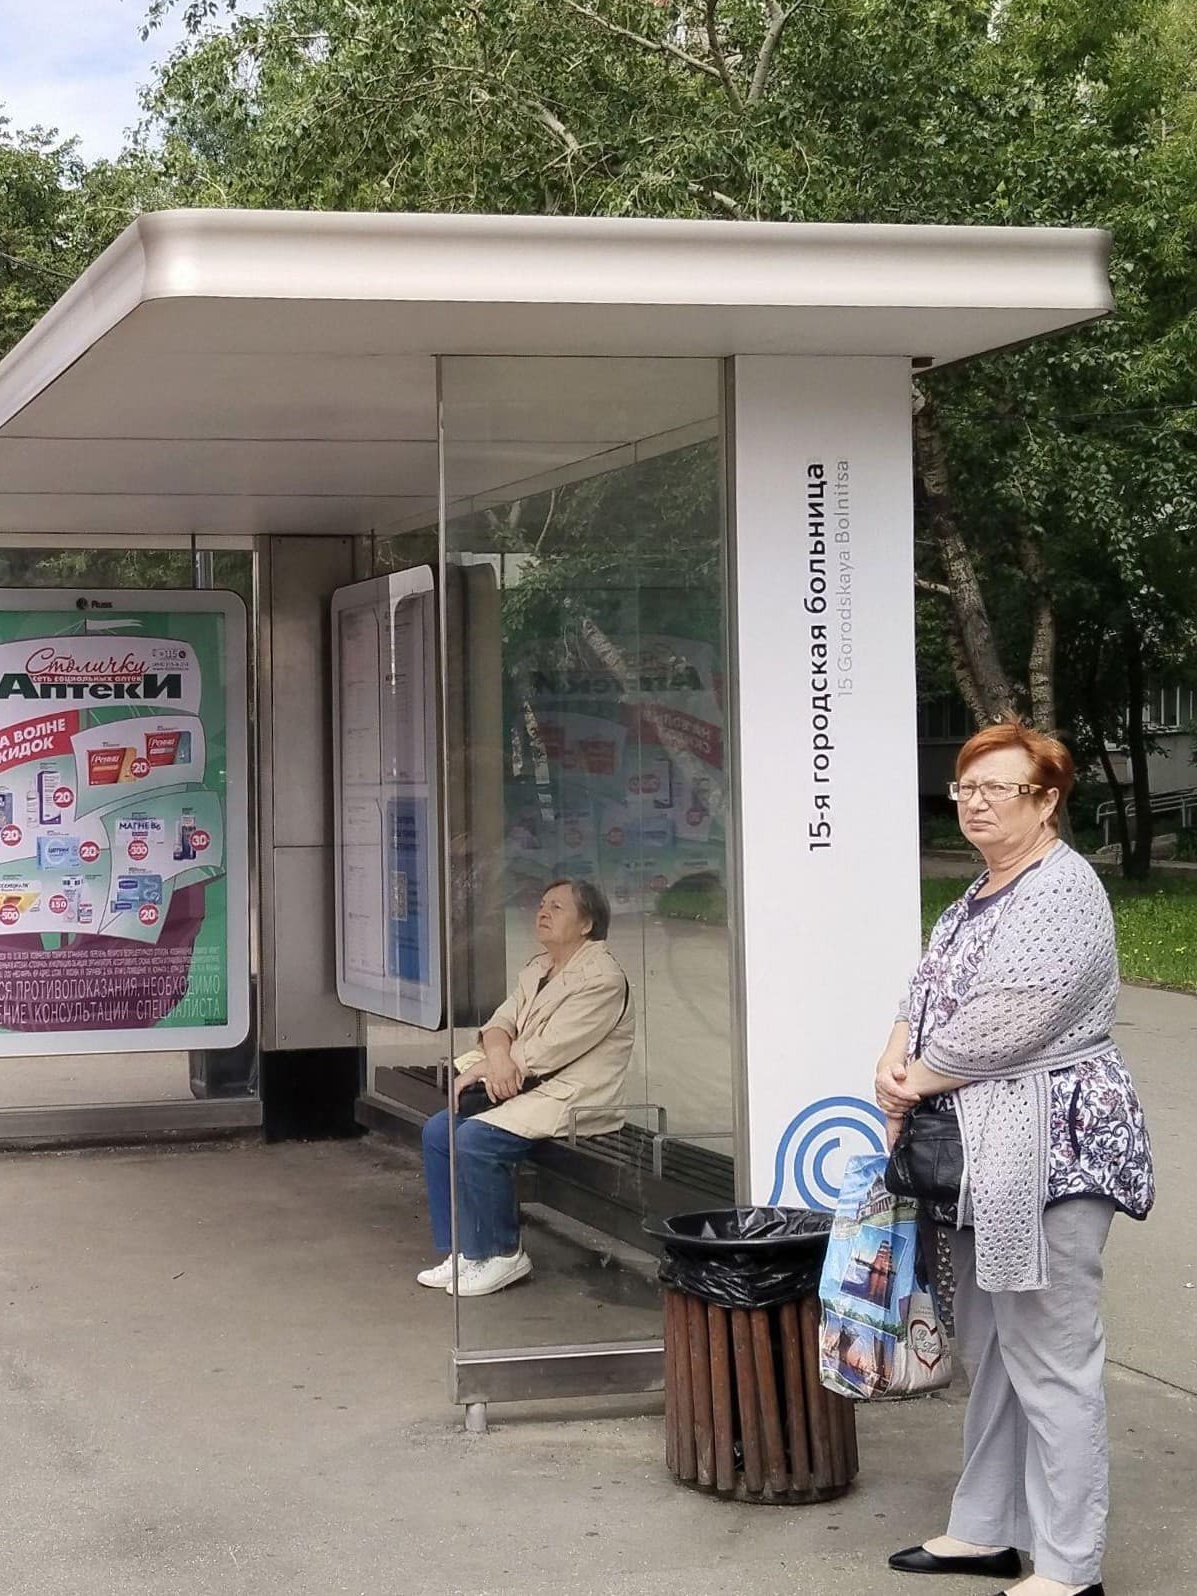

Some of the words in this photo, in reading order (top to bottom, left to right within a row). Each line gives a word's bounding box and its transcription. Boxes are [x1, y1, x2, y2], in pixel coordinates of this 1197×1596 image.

[834, 460, 850, 543] Bolnitsa
[803, 463, 827, 614] больница
[835, 551, 854, 672] Gorodskaya
[25, 647, 149, 674] Столички
[54, 675, 113, 683] социальных
[838, 678, 852, 697] 15
[811, 625, 835, 782] городская
[13, 718, 66, 744] ВОЛНЕ
[809, 795, 832, 851] 15-я
[143, 975, 221, 997] НЕОБХОДИМО
[34, 1001, 129, 1023] КОНСУЛЬТАЦИИ
[136, 998, 221, 1020] СПЕЦИАЛИСТА
